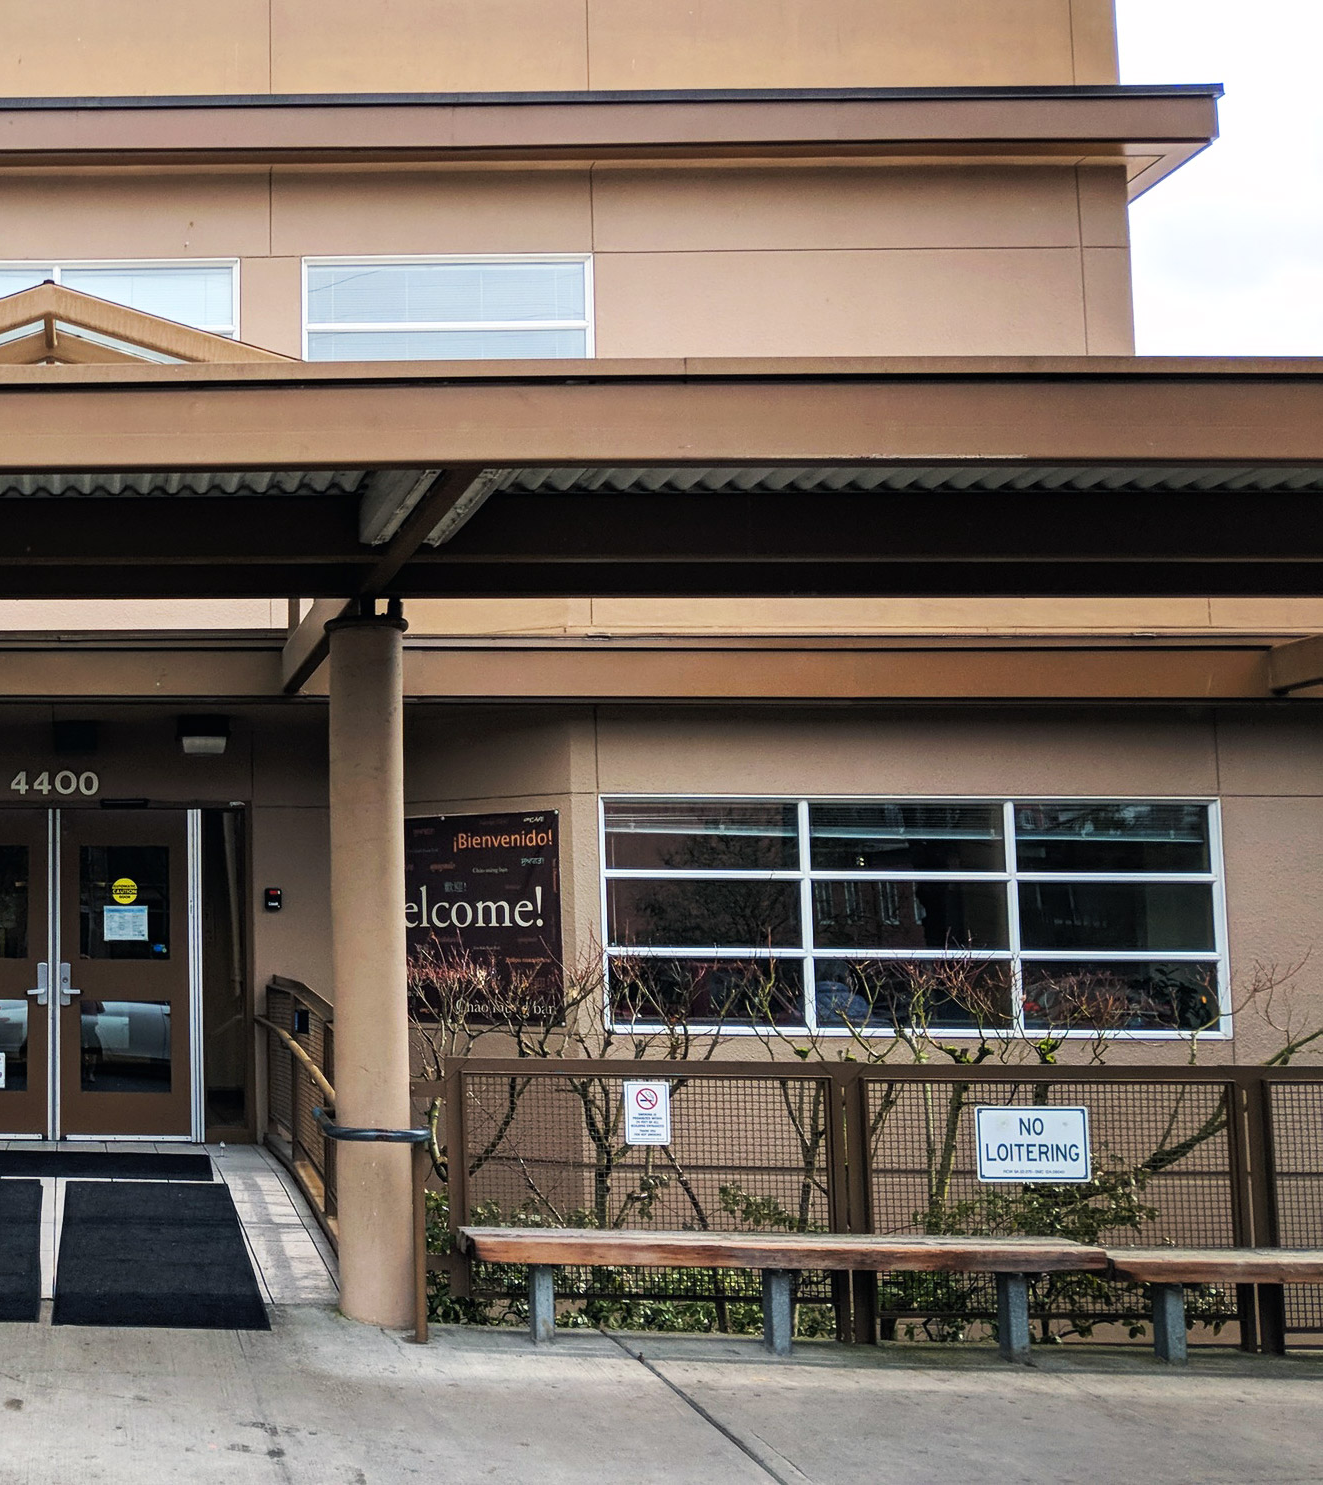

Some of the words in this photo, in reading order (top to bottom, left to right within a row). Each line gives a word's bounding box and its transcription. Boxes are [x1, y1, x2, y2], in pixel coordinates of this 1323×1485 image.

[10, 770, 99, 796] 4400
[453, 829, 553, 853] ¡Bienvenido!
[1019, 1117, 1044, 1136] NO
[985, 1143, 1080, 1162] LOITERING
